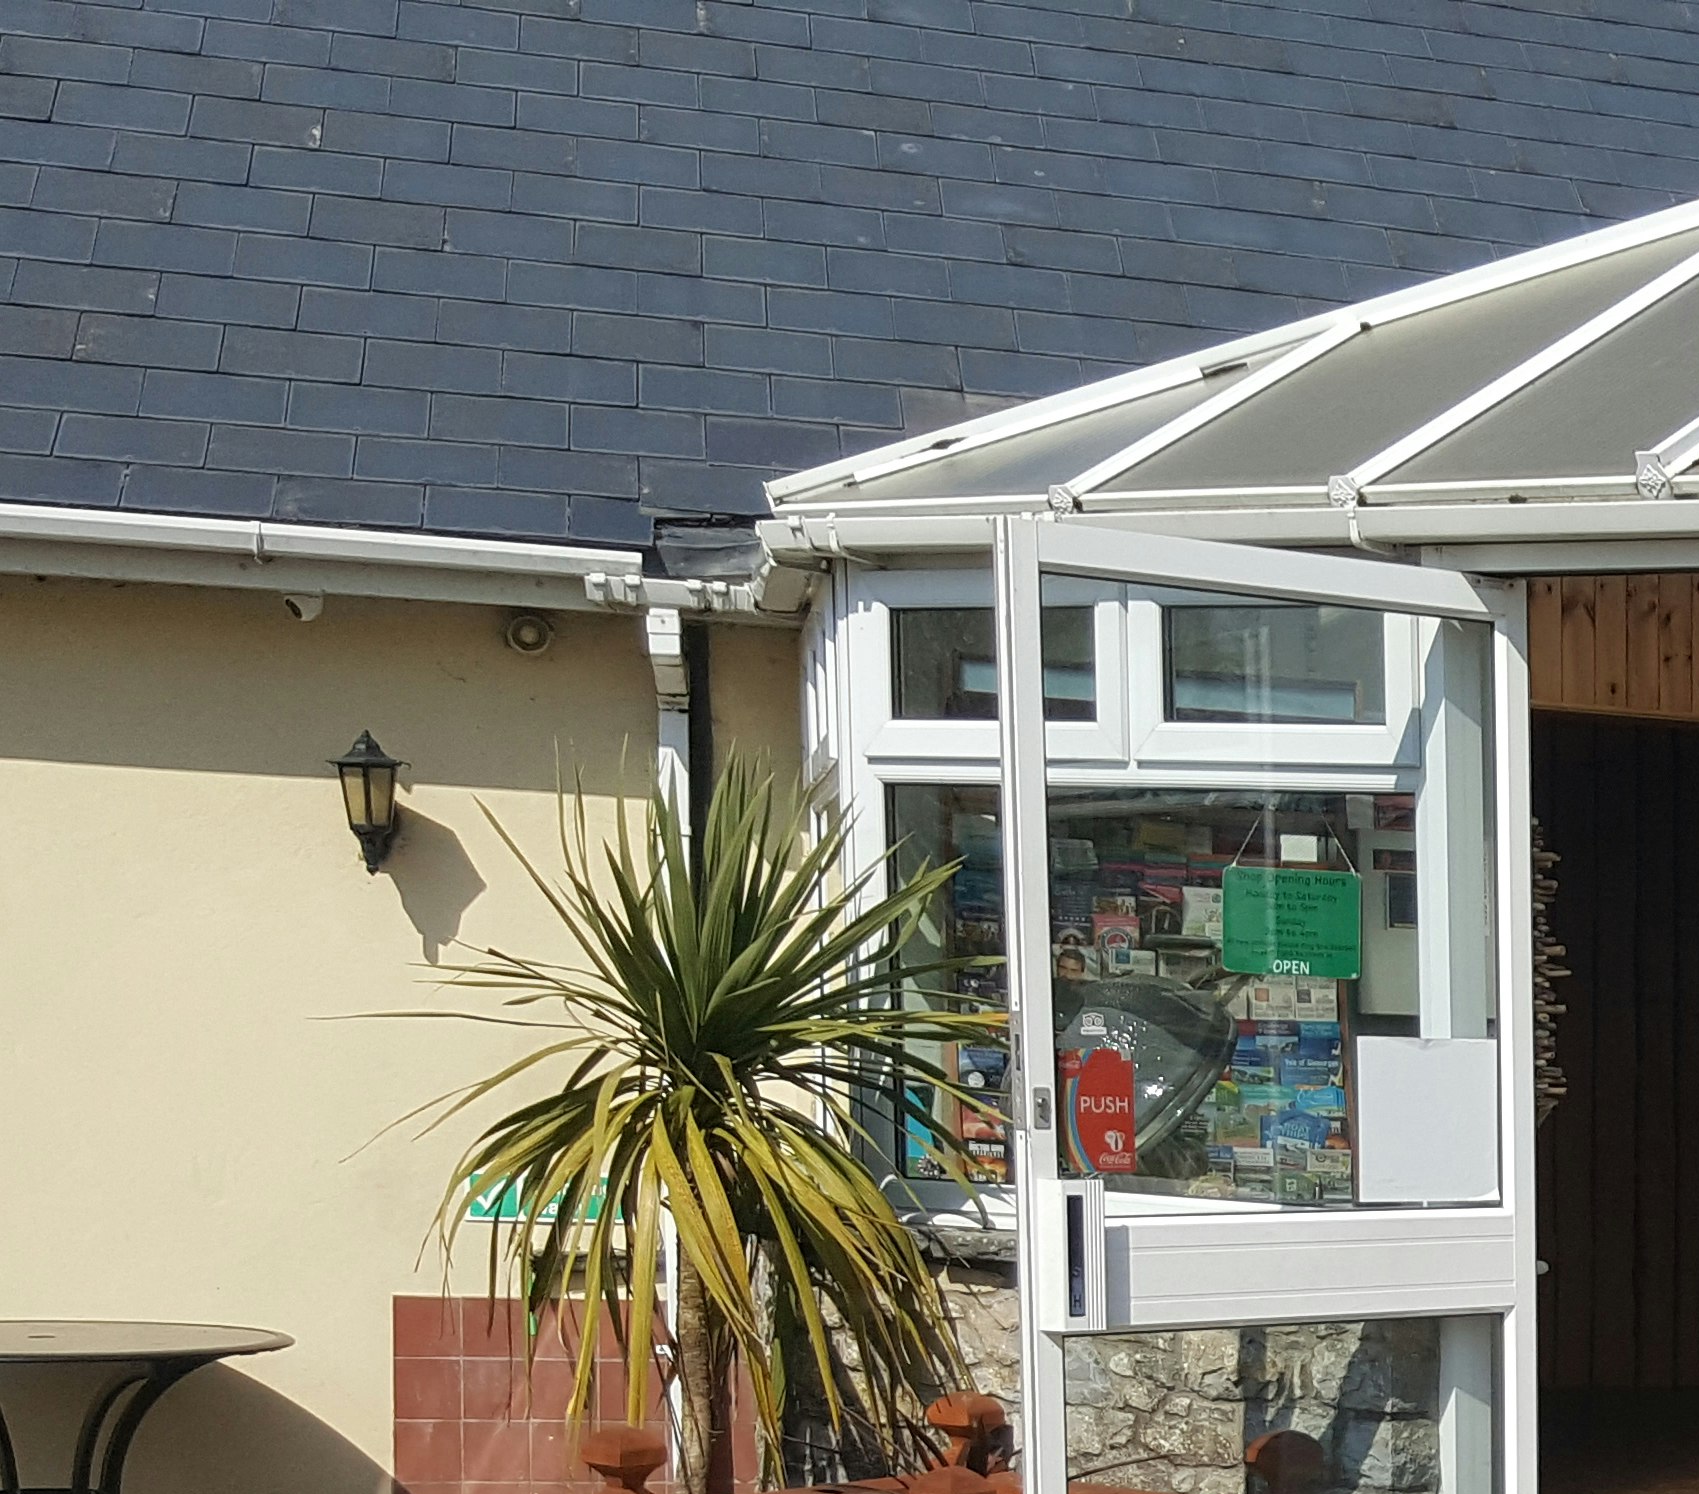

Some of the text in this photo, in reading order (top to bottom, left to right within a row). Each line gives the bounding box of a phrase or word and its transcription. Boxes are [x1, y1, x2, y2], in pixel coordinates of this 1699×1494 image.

[1315, 874, 1347, 887] Hours
[1296, 891, 1337, 903] Saturday
[1272, 959, 1310, 975] OPEN
[1080, 1096, 1129, 1113] PUSH
